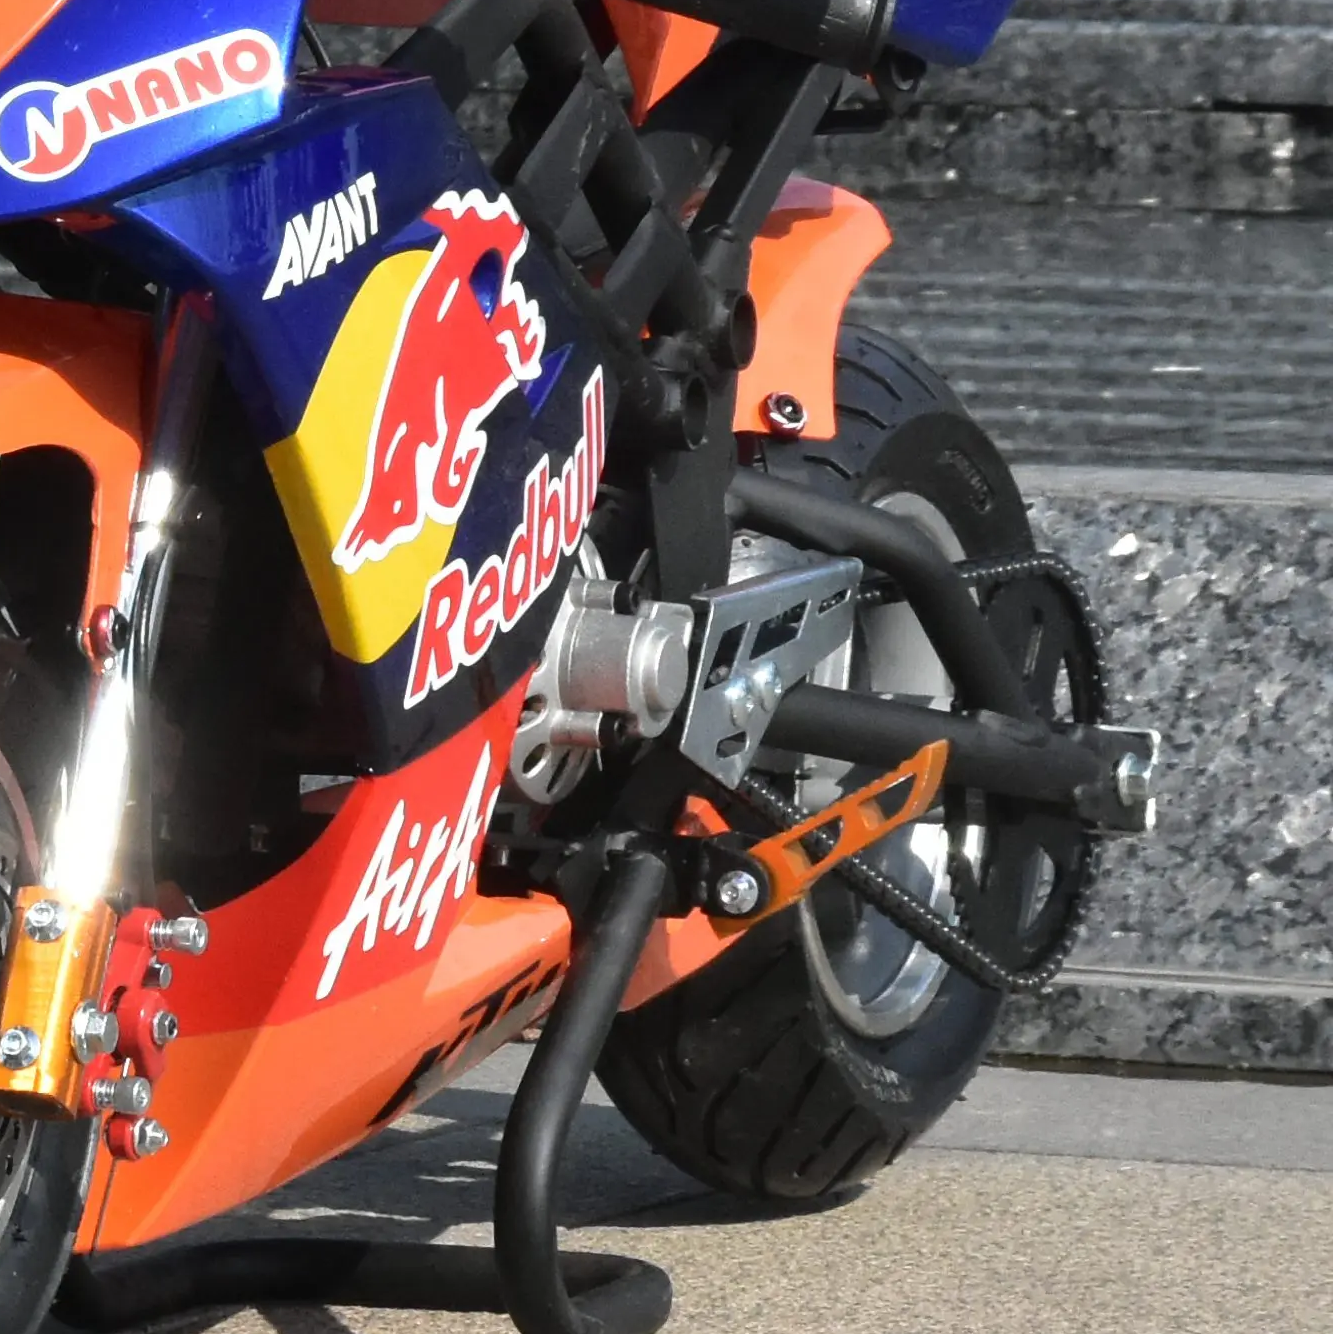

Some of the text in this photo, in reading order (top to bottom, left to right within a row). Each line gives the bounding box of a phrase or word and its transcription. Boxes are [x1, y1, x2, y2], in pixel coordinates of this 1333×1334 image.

[86, 38, 271, 133] NANO
[263, 172, 380, 300] AVANT
[404, 364, 605, 709] Redbull
